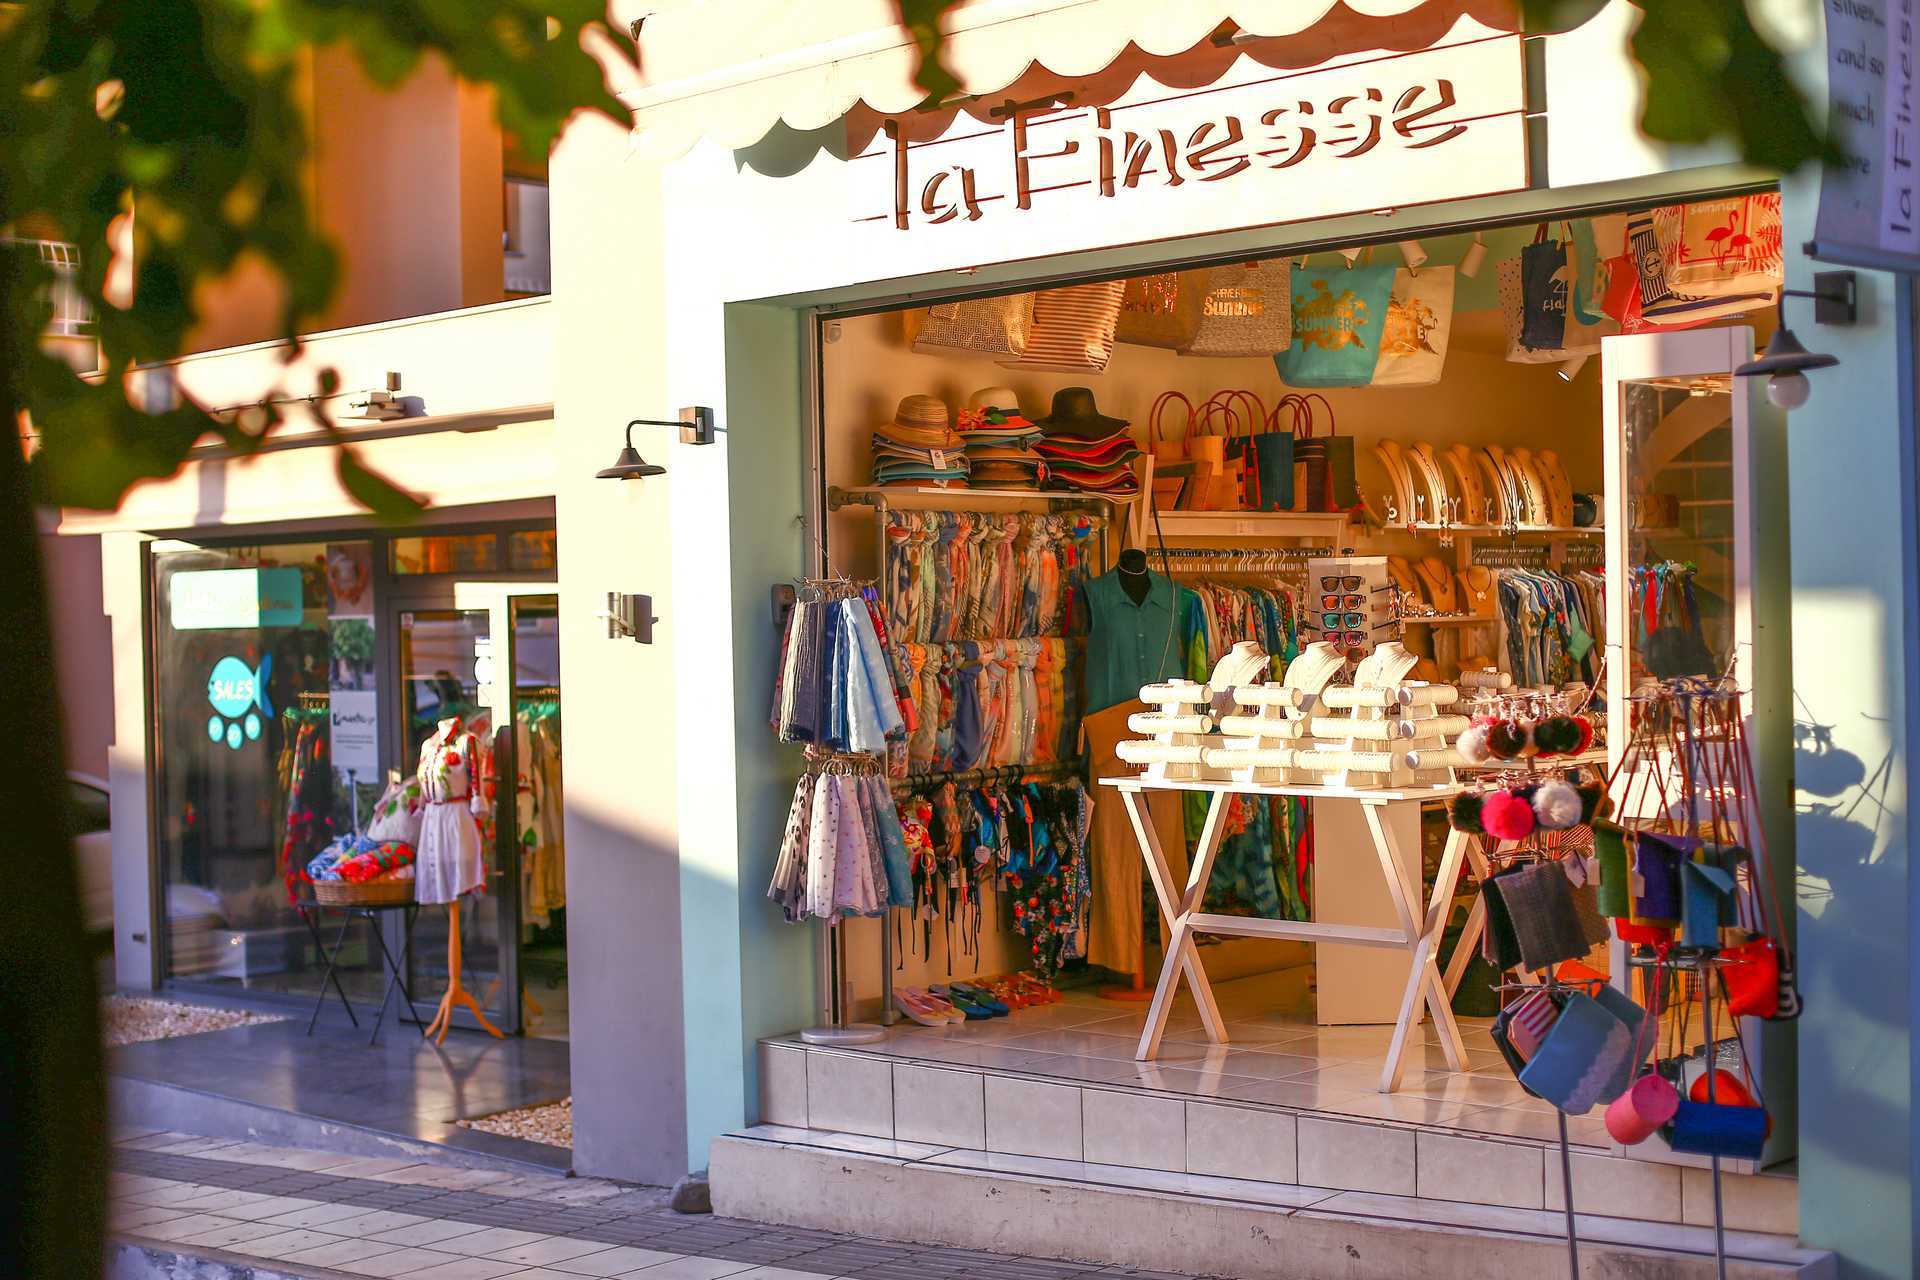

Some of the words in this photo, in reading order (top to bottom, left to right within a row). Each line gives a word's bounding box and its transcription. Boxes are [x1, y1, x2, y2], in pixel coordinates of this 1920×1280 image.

[1838, 41, 1866, 71] and
[1869, 57, 1885, 77] so
[888, 119, 984, 231] la
[992, 79, 1468, 209] Finesse
[1890, 188, 1911, 233] la
[213, 677, 254, 702] SALES
